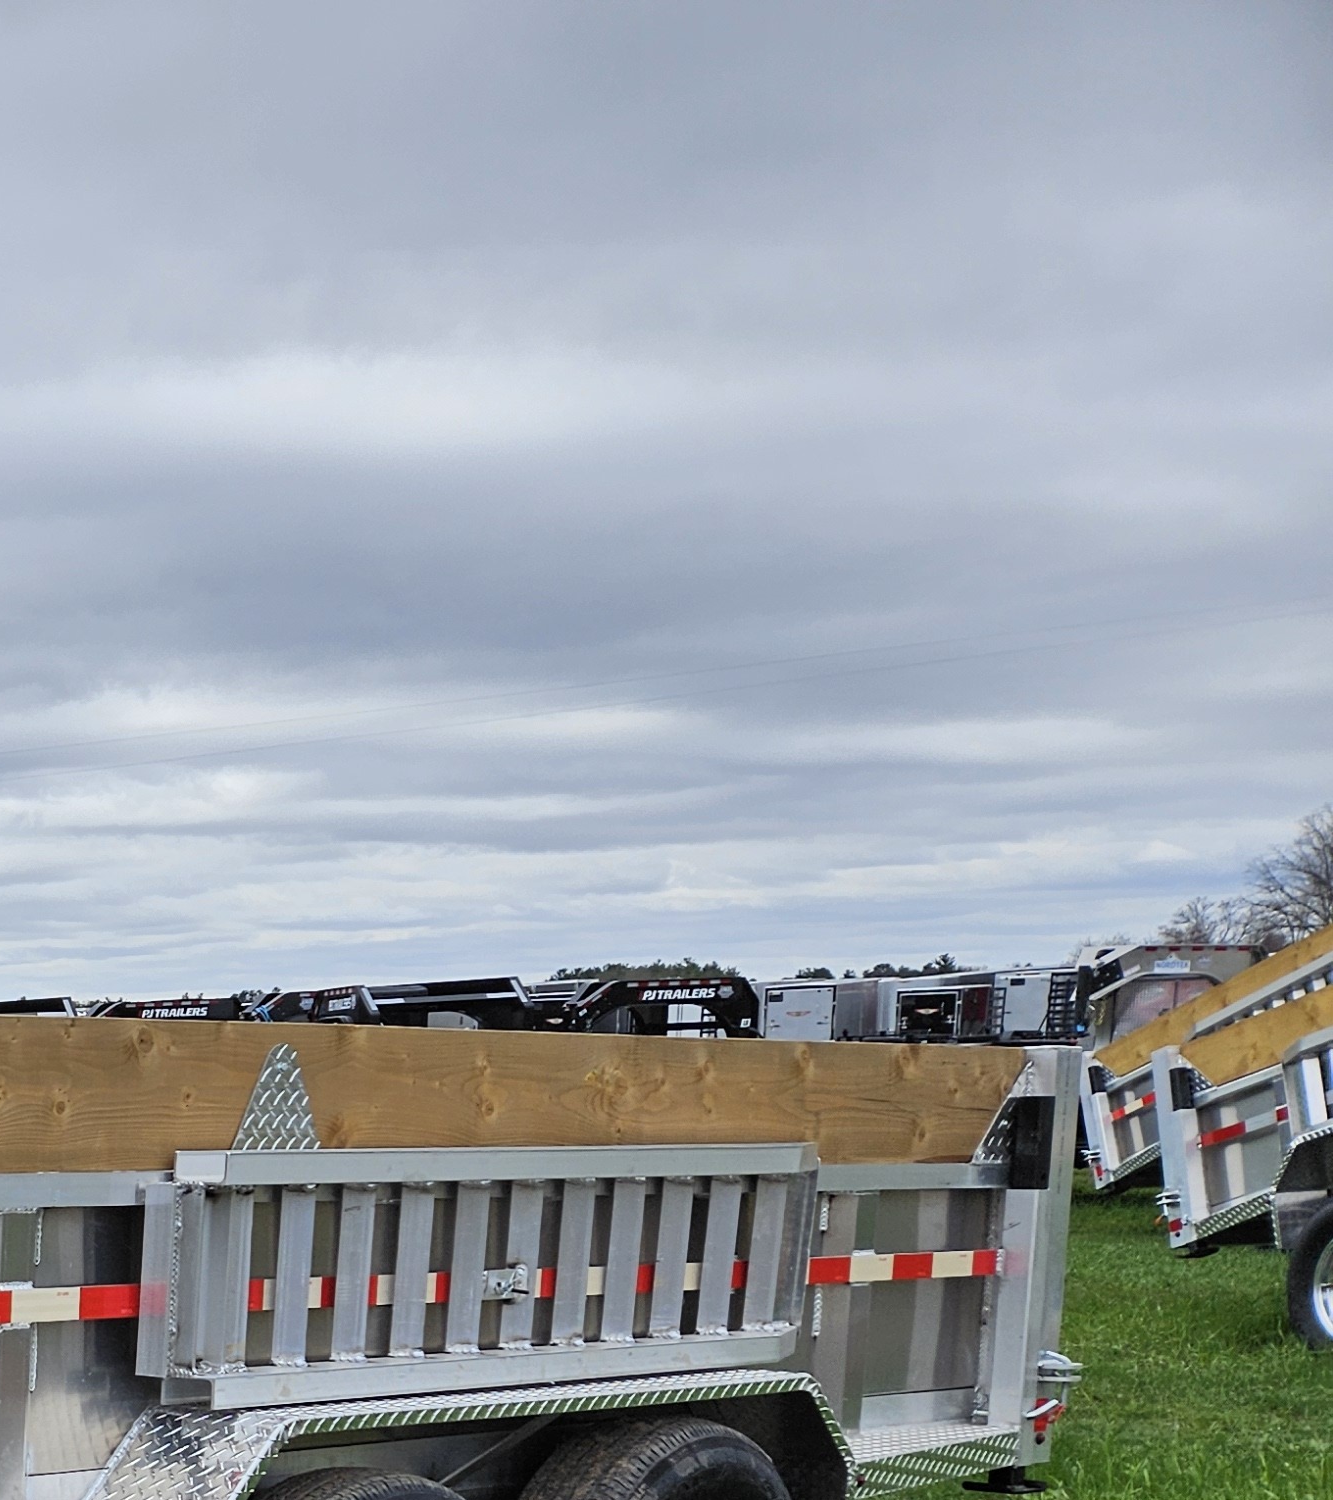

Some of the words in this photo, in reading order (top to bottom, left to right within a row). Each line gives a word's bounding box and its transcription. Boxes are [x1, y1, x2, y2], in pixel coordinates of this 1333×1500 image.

[642, 990, 655, 1000] PJ
[657, 988, 716, 999] TRAILERS
[142, 1008, 155, 1019] PJ
[155, 1007, 208, 1018] TRAILERS
